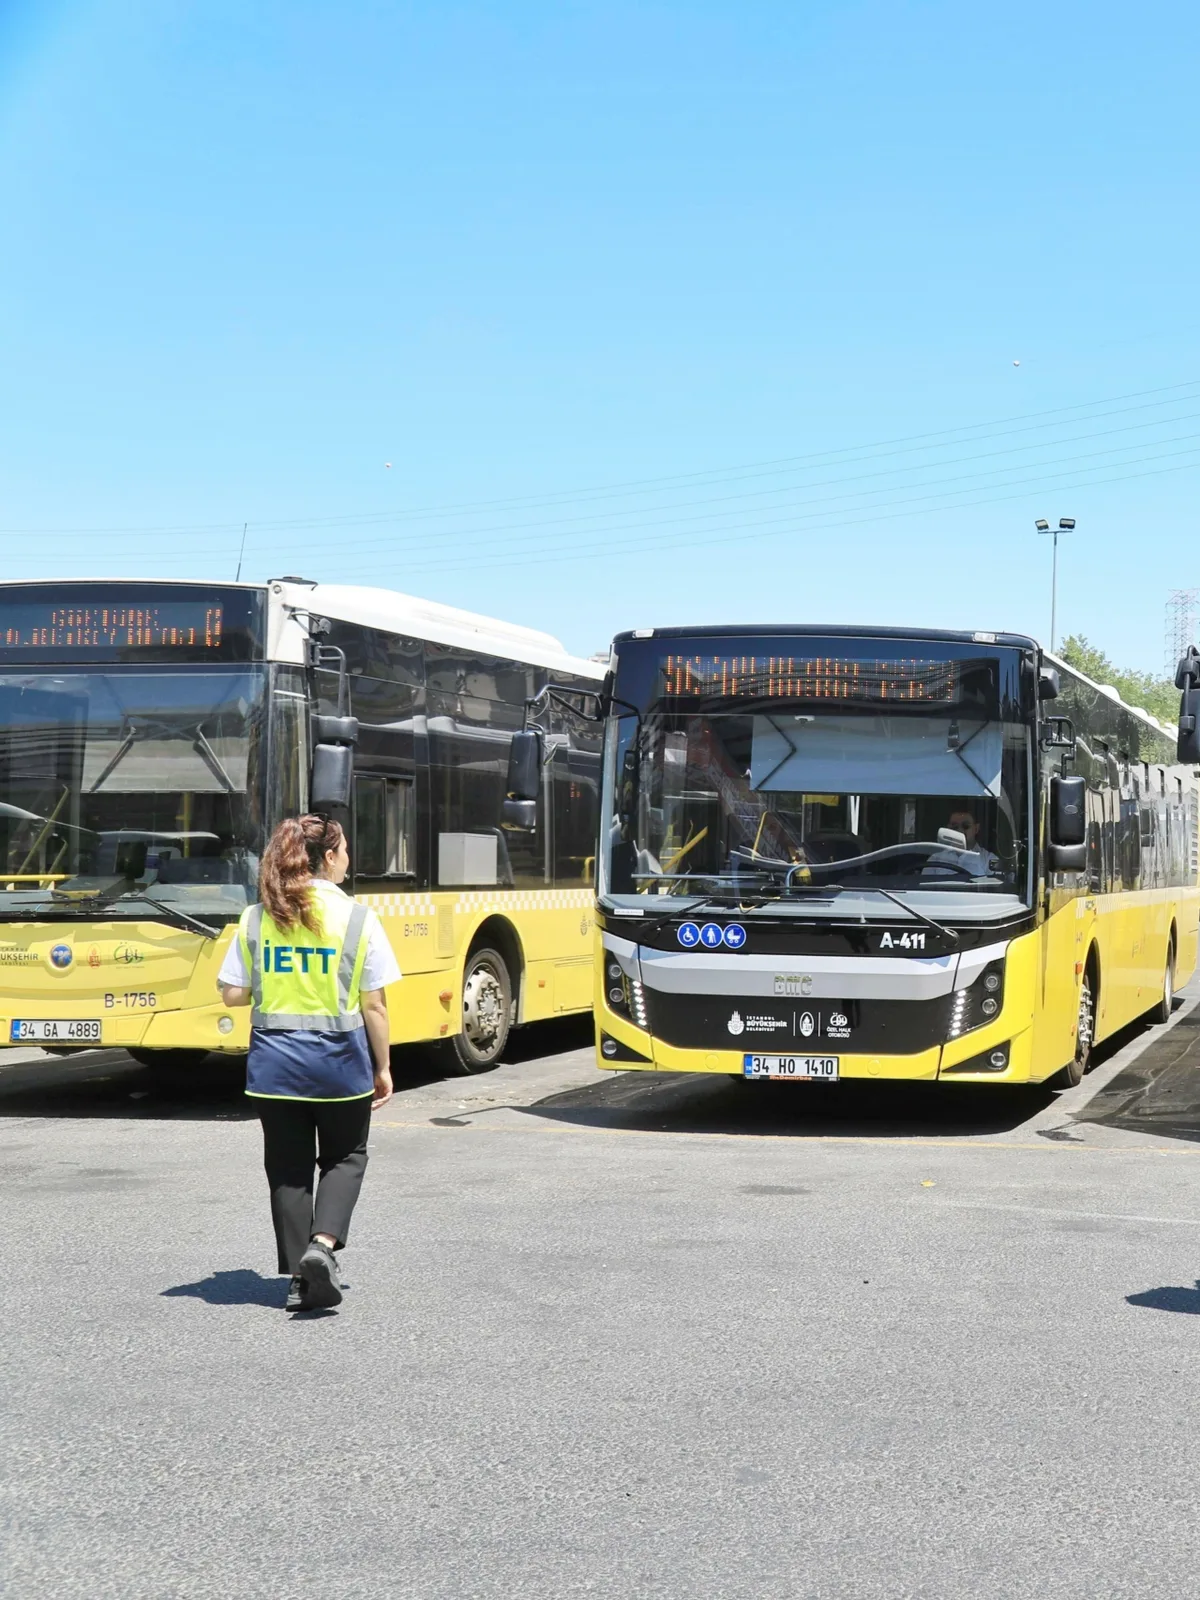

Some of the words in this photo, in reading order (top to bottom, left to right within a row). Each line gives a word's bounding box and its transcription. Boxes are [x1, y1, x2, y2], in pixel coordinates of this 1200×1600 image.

[879, 932, 925, 949] A-411
[774, 975, 813, 996] BMC
[104, 992, 157, 1008] B-1756
[20, 1023, 35, 1037] 34
[44, 1023, 58, 1037] GA
[68, 1023, 98, 1037] 4889
[753, 1057, 769, 1073] 34
[779, 1058, 795, 1074] HO
[804, 1059, 833, 1075] 1410
